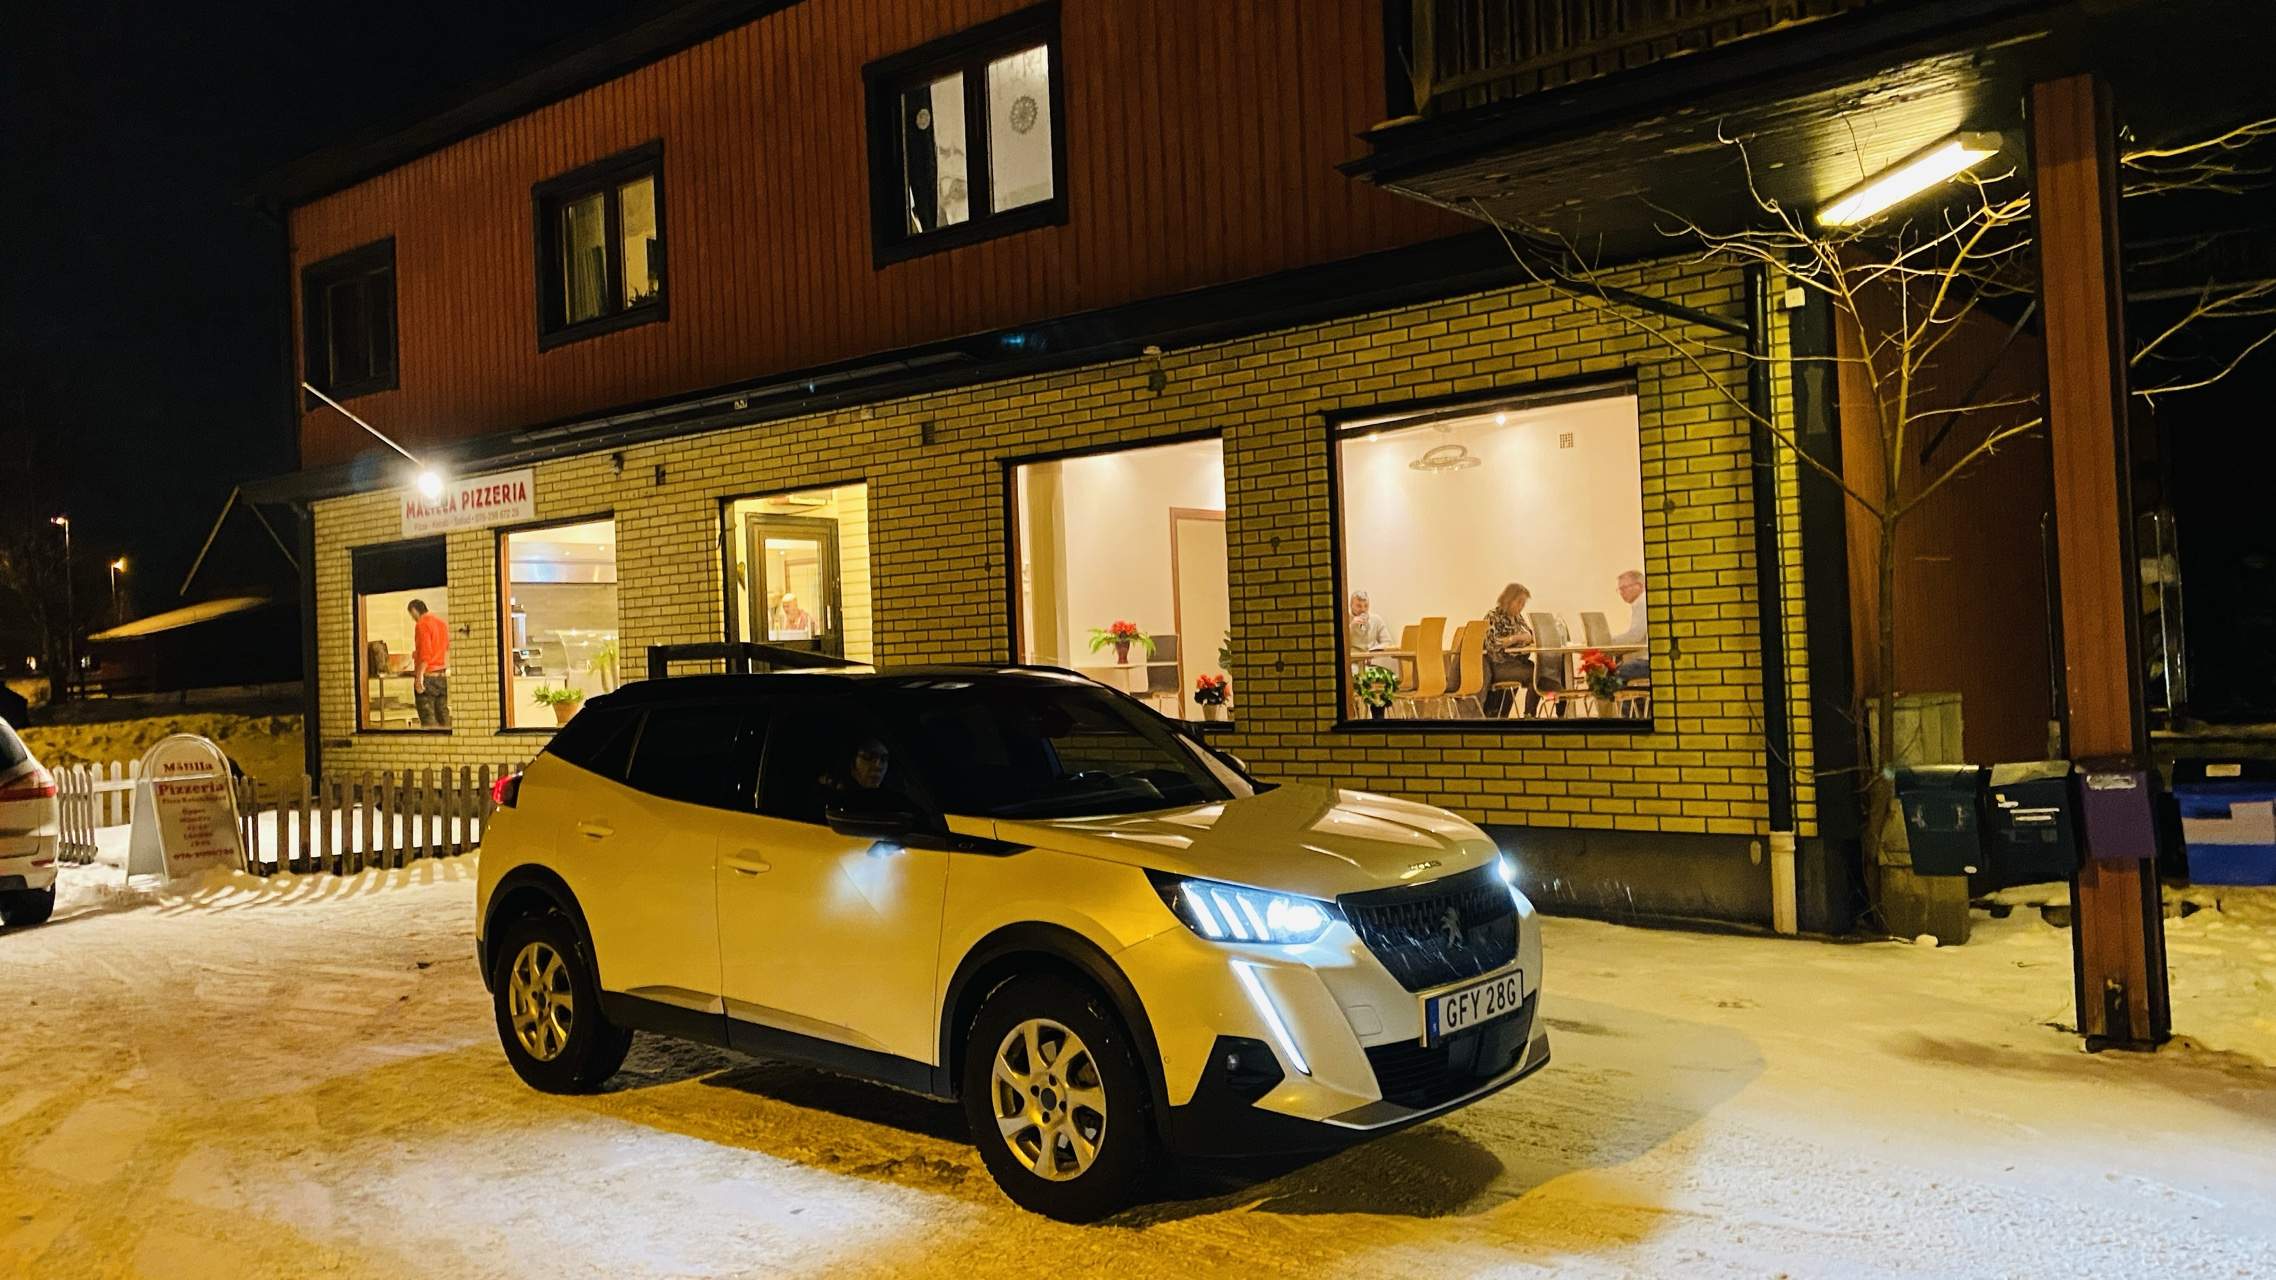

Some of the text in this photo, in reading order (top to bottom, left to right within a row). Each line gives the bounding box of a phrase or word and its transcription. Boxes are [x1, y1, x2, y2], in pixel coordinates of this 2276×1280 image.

[462, 481, 527, 510] PIZZERIA
[158, 782, 224, 795] Pizzeria
[1447, 977, 1516, 1028] GFY 28G
